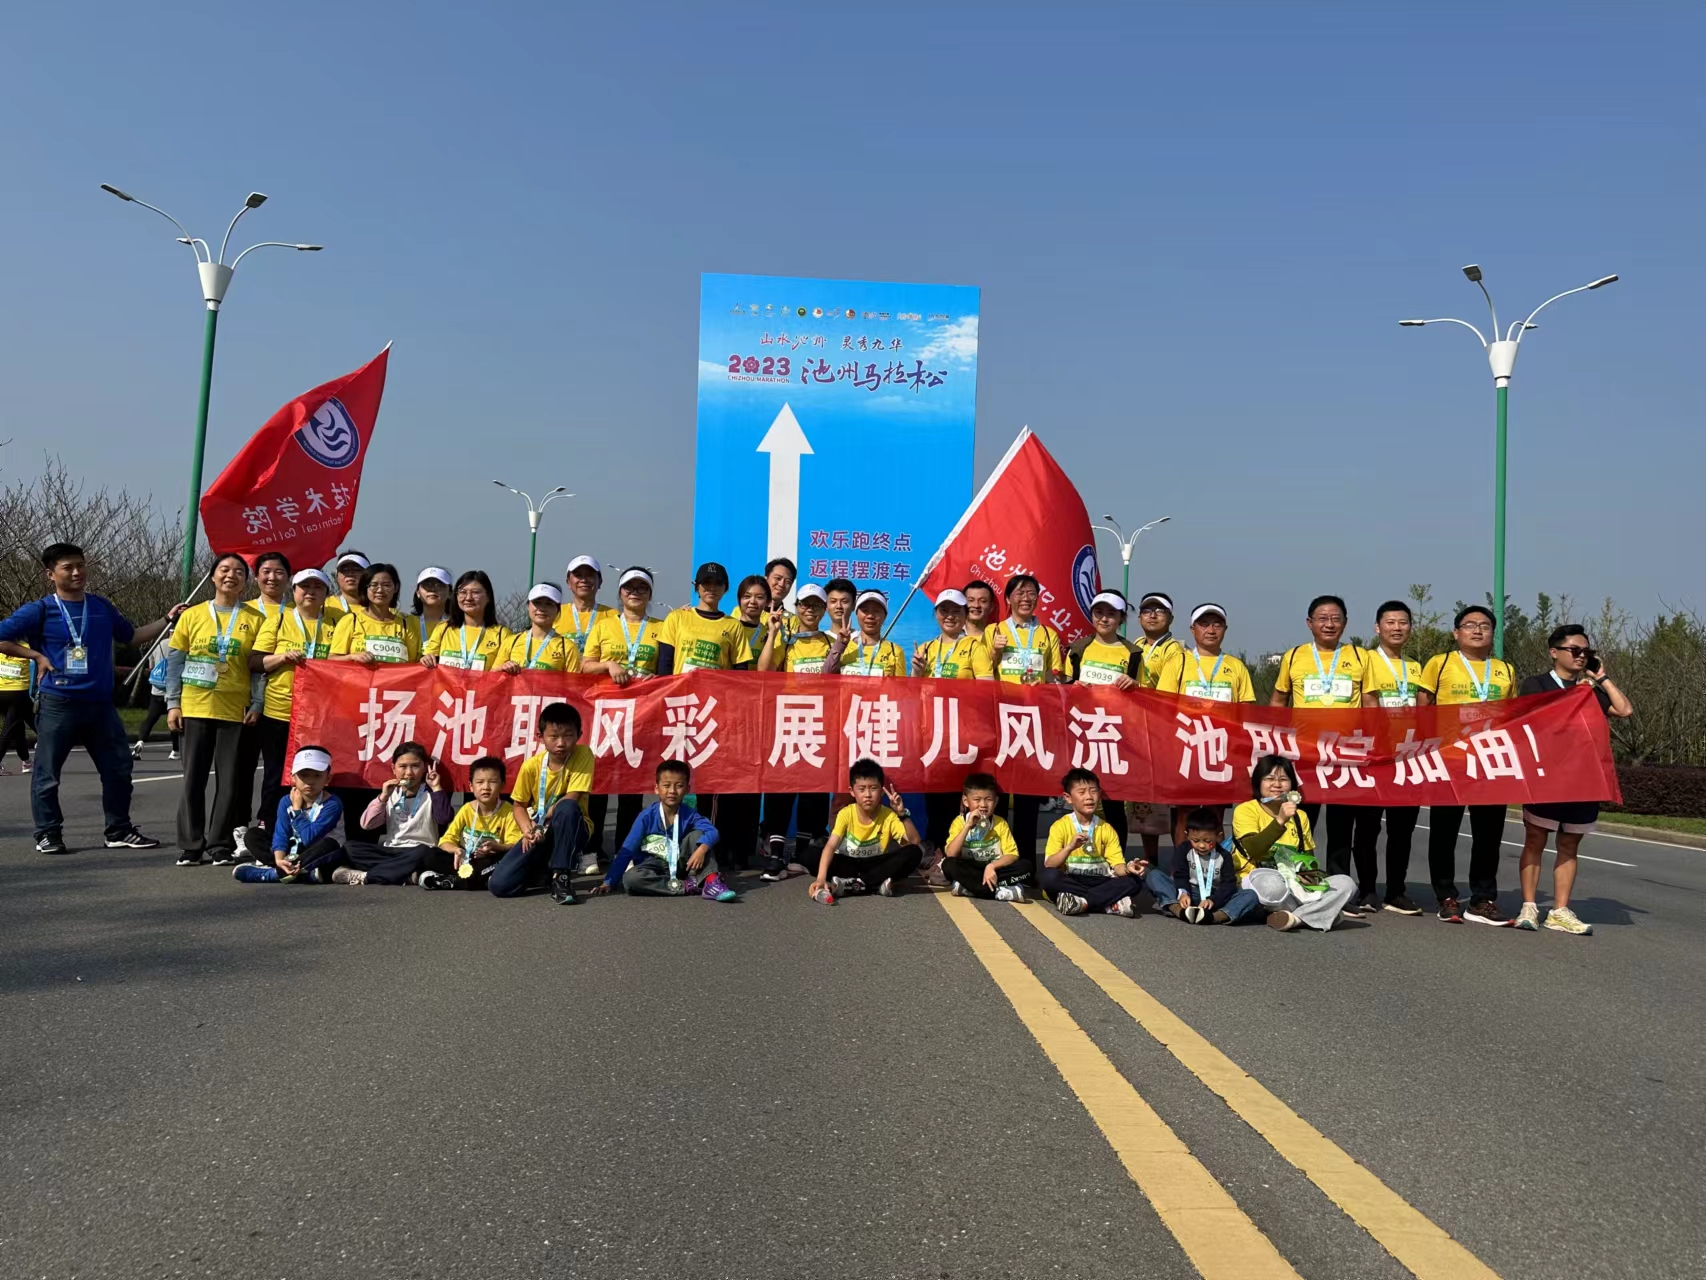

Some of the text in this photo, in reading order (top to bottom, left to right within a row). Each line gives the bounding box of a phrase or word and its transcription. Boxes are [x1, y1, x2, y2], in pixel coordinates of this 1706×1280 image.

[841, 335, 903, 353] 灵秀九华
[757, 376, 790, 384] MARATHON
[800, 357, 948, 394] 池州马拉松
[810, 530, 912, 552] 欢乐跑终点
[809, 559, 911, 582] 返程摆渡车
[970, 563, 1003, 595] Chizhou
[373, 643, 401, 654] C9049
[1007, 656, 1032, 665] C901
[1086, 670, 1113, 682] C9039
[1310, 683, 1340, 692] C93
[358, 686, 720, 770] 扬池职风彩
[767, 692, 1130, 777] 展健儿风流
[845, 846, 873, 856] C9290
